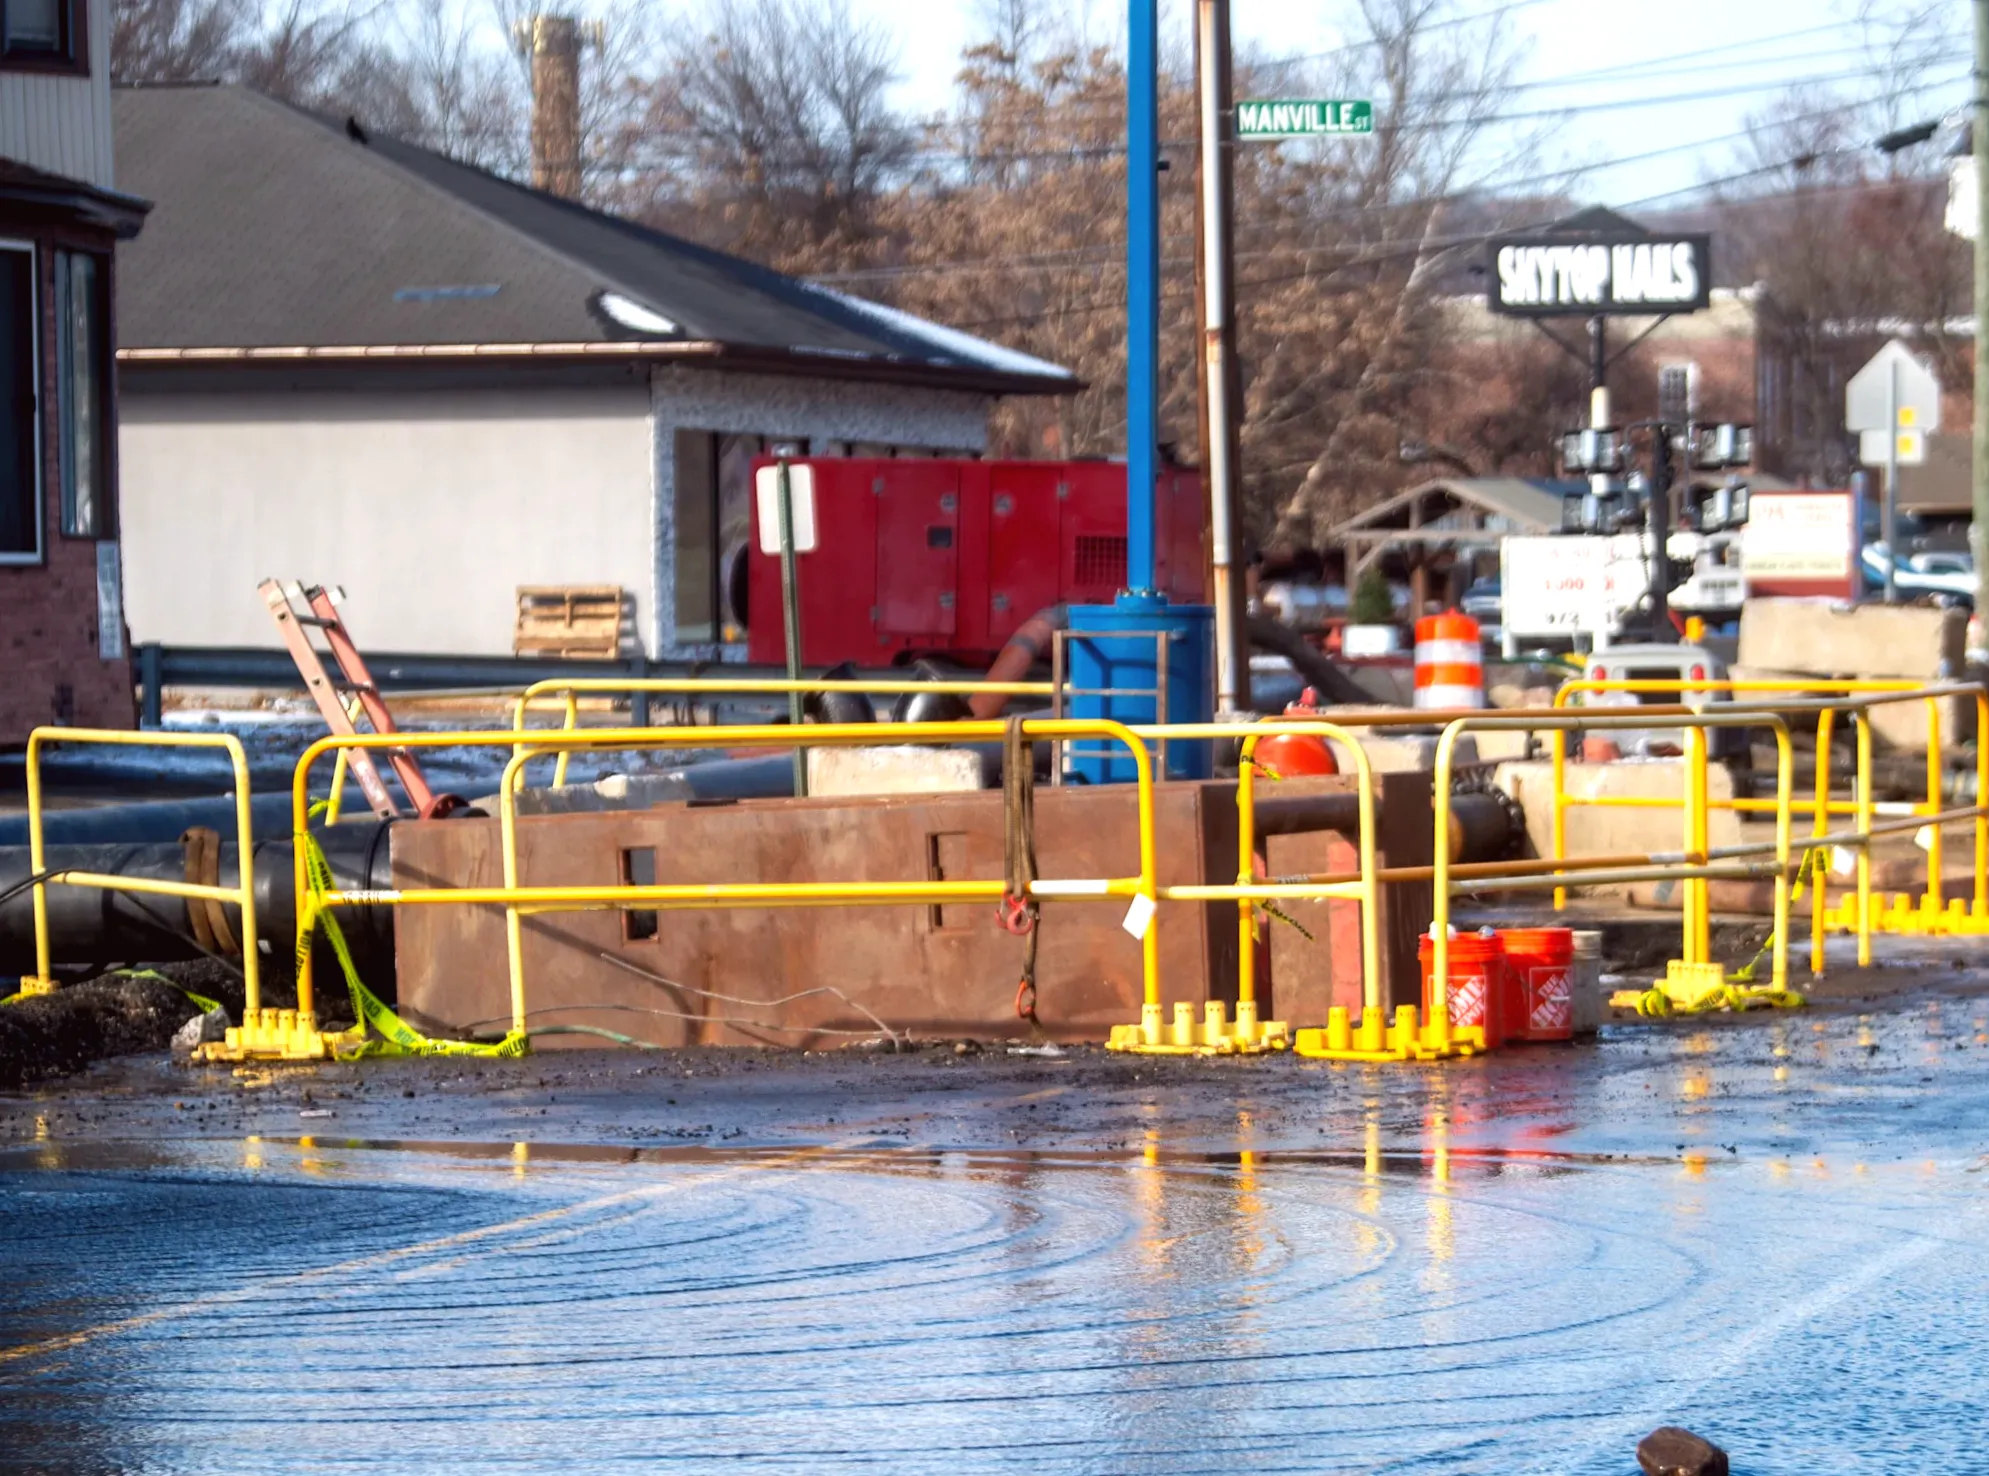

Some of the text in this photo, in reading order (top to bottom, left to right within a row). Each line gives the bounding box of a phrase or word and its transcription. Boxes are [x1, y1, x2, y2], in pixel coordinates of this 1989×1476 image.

[1238, 102, 1369, 132] MANVILLE ST
[1498, 244, 1609, 304] SKYTOP
